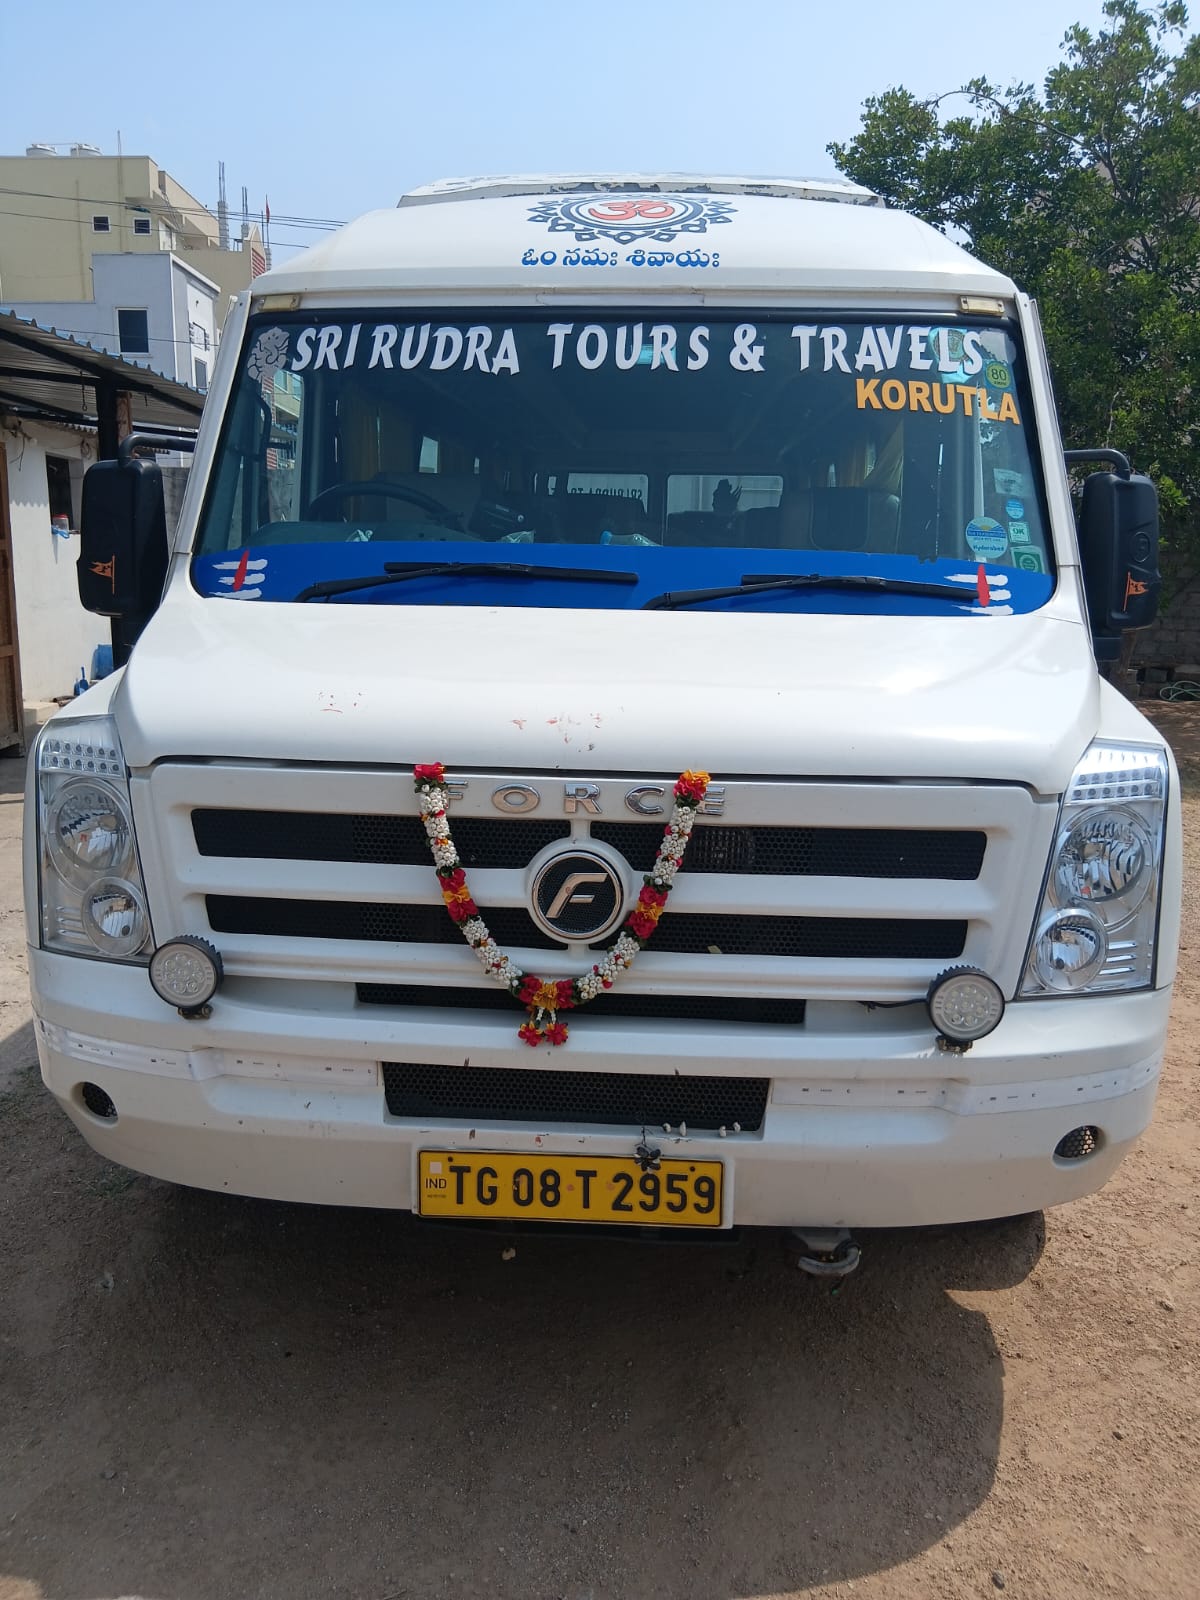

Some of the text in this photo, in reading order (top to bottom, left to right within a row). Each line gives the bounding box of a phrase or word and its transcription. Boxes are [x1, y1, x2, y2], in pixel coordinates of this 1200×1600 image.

[521, 248, 720, 268] ఓం నమః శివాయః
[290, 323, 362, 371] SRI
[368, 323, 520, 376] RUDRA
[547, 323, 709, 373] TOURS
[728, 323, 765, 372] &
[791, 325, 985, 375] TRAVELS
[991, 368, 1007, 381] 80
[856, 378, 1021, 425] KORUTLA
[444, 779, 726, 816] FORCE
[425, 1178, 447, 1190] IND
[449, 1165, 716, 1215] TG 08 T 2959
